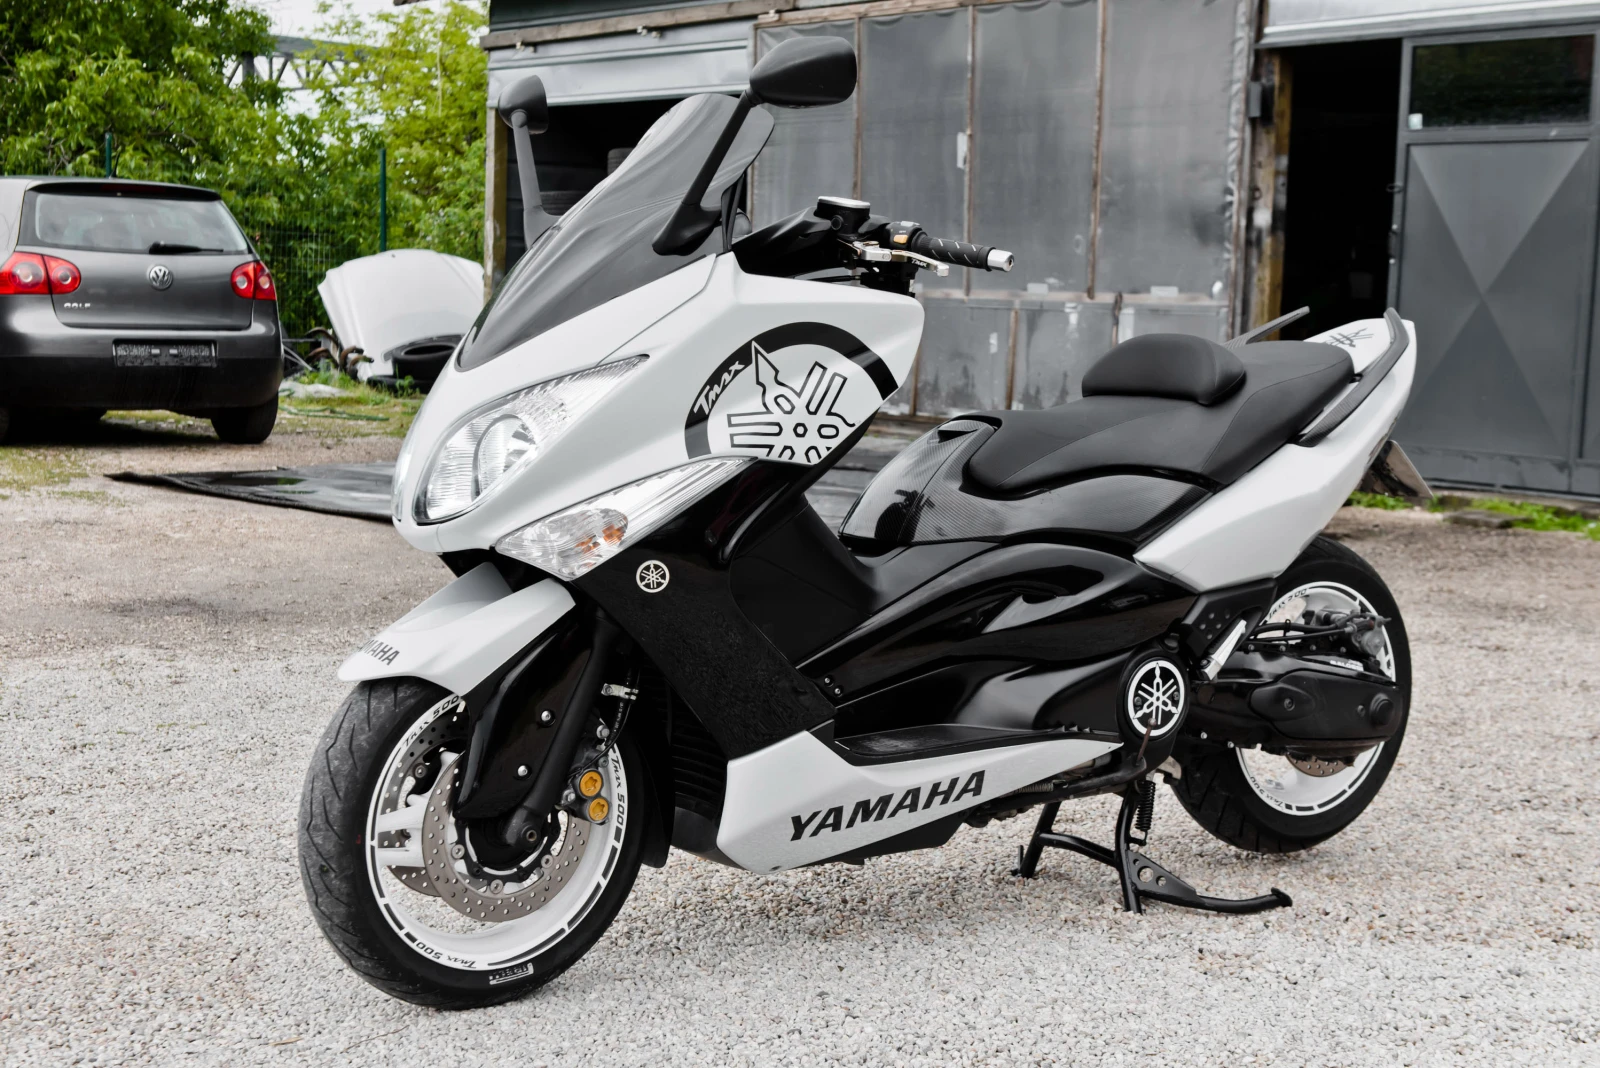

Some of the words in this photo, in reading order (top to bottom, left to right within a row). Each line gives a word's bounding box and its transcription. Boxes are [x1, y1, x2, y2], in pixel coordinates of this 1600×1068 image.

[63, 302, 91, 310] GOLF
[433, 695, 460, 719] 500
[617, 793, 625, 826] 500
[790, 770, 986, 842] YAMAHA
[415, 942, 443, 960] 500
